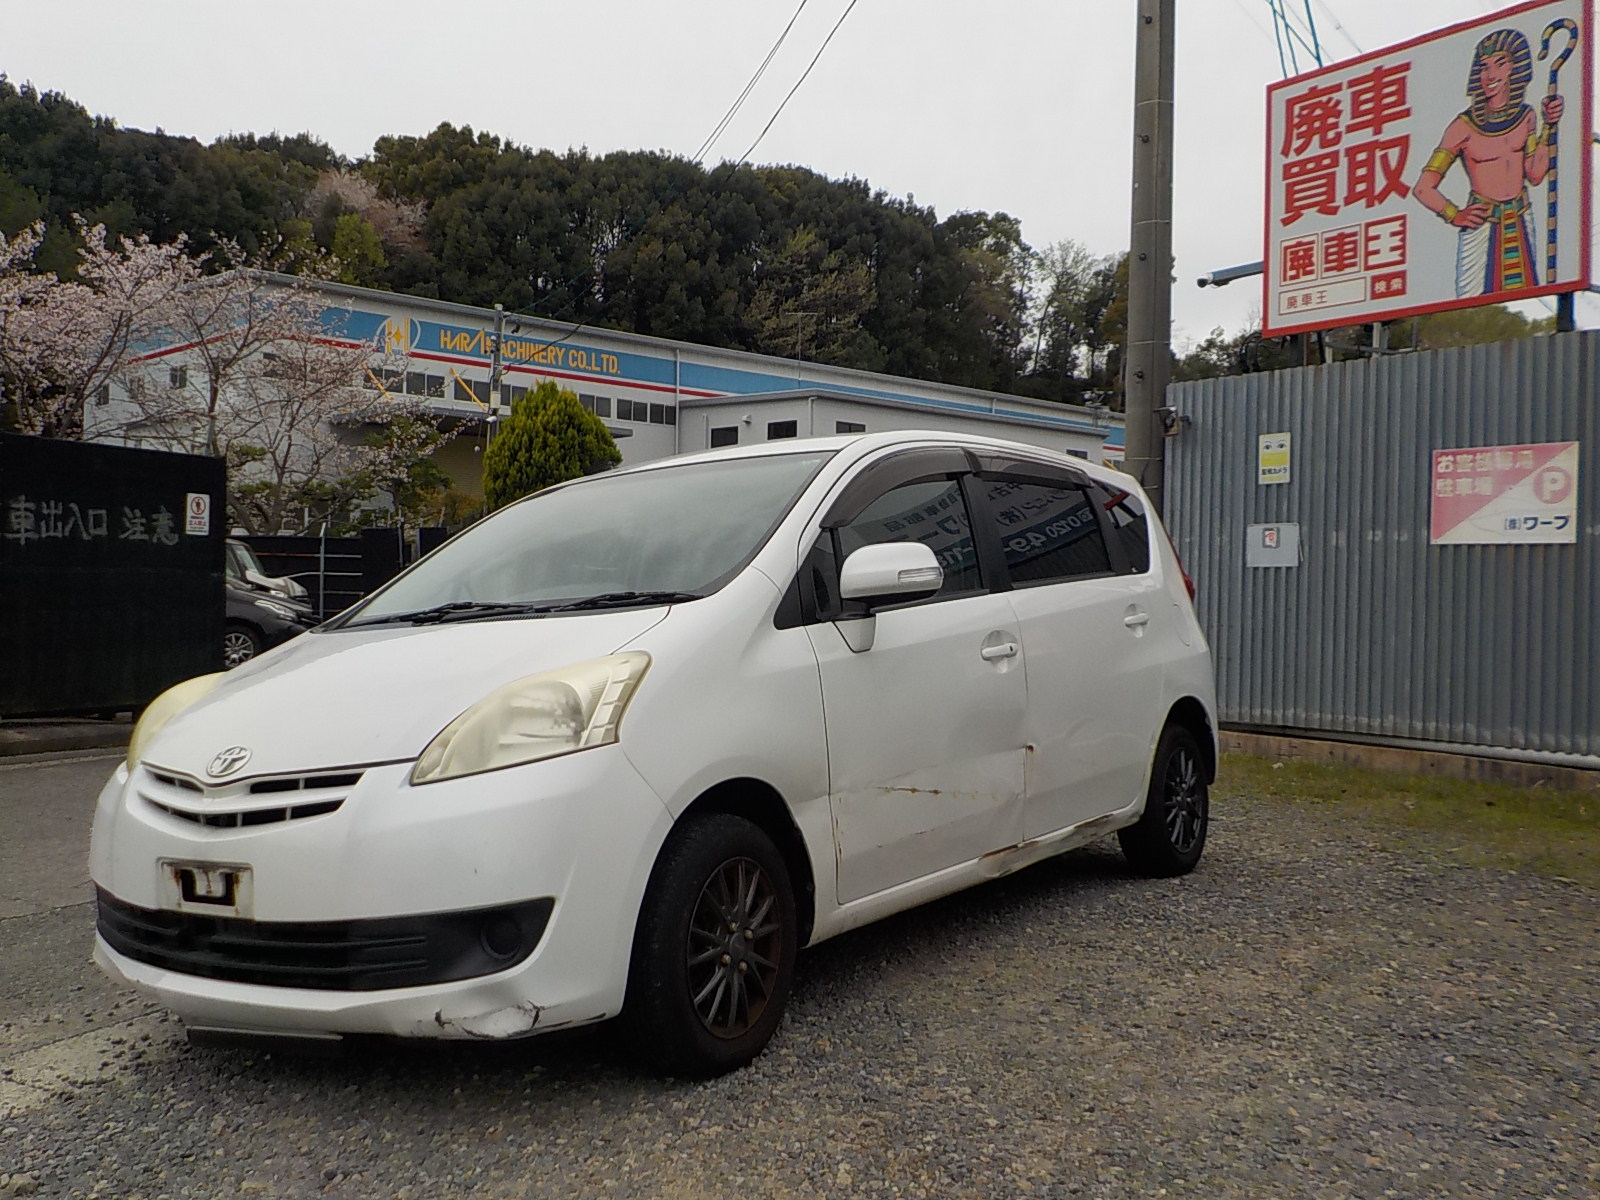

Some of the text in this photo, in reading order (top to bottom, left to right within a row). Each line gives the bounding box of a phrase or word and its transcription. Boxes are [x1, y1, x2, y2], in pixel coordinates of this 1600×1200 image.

[1281, 61, 1411, 158] 廃車
[1280, 133, 1411, 226] 買取
[1281, 215, 1407, 286] 廃車王
[1287, 290, 1327, 309] 廃車王
[439, 329, 486, 355] HARA
[118, 504, 179, 546] 注意
